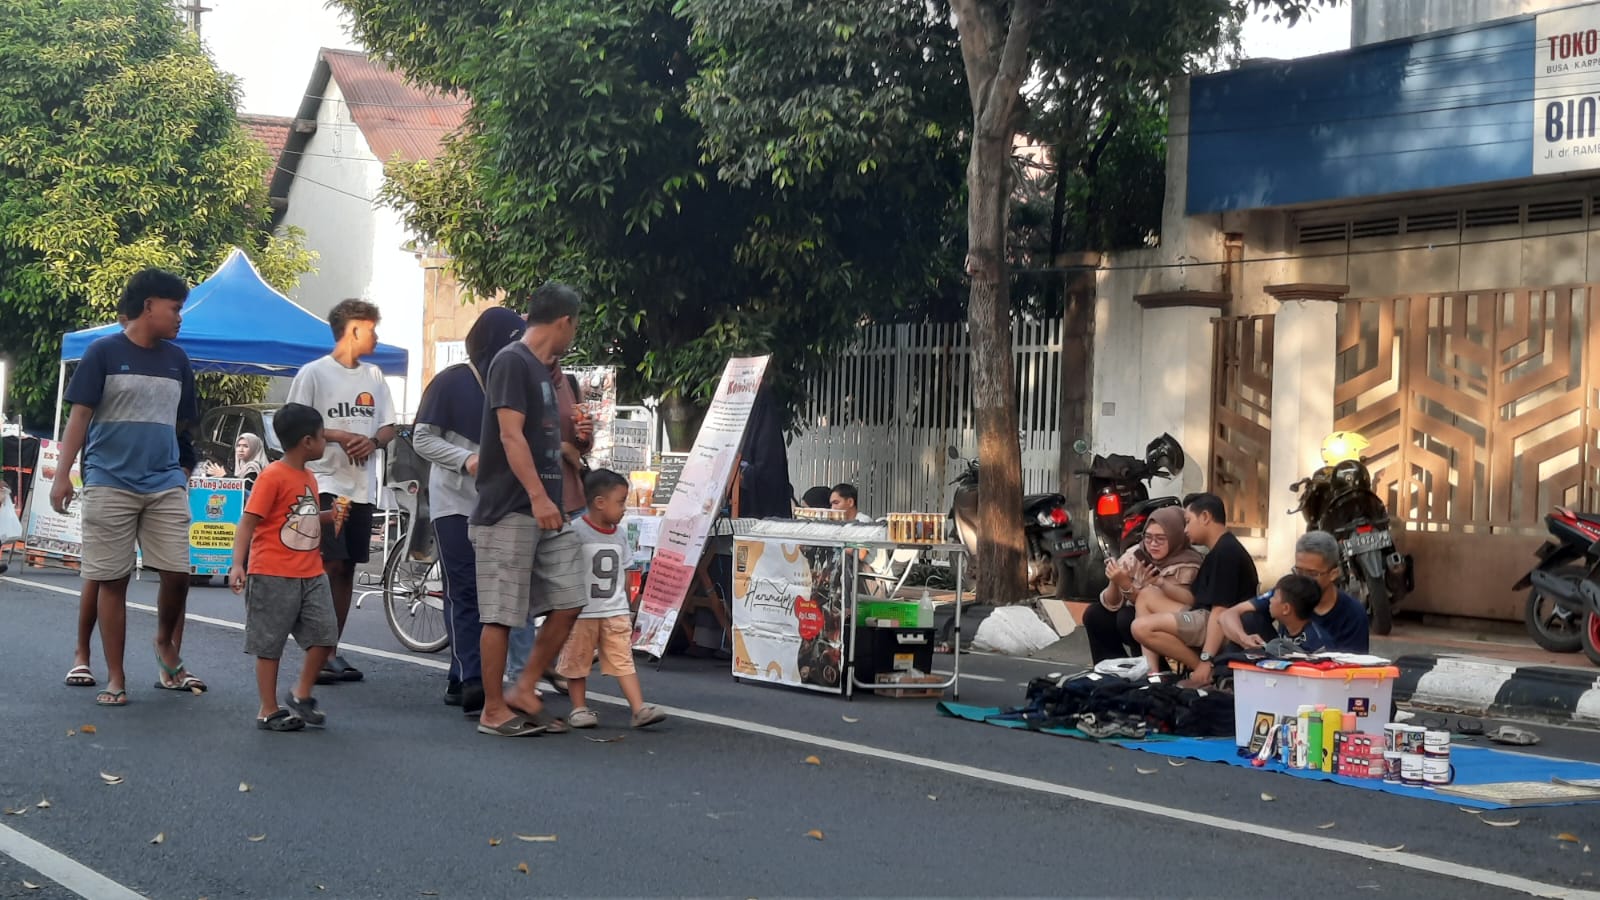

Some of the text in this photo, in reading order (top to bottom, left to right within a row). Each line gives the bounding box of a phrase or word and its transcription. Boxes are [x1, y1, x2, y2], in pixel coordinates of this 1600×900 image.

[1547, 28, 1598, 61] TOKO
[1546, 63, 1569, 74] BUSA
[1545, 96, 1600, 143] BIN
[591, 549, 619, 598] 9
